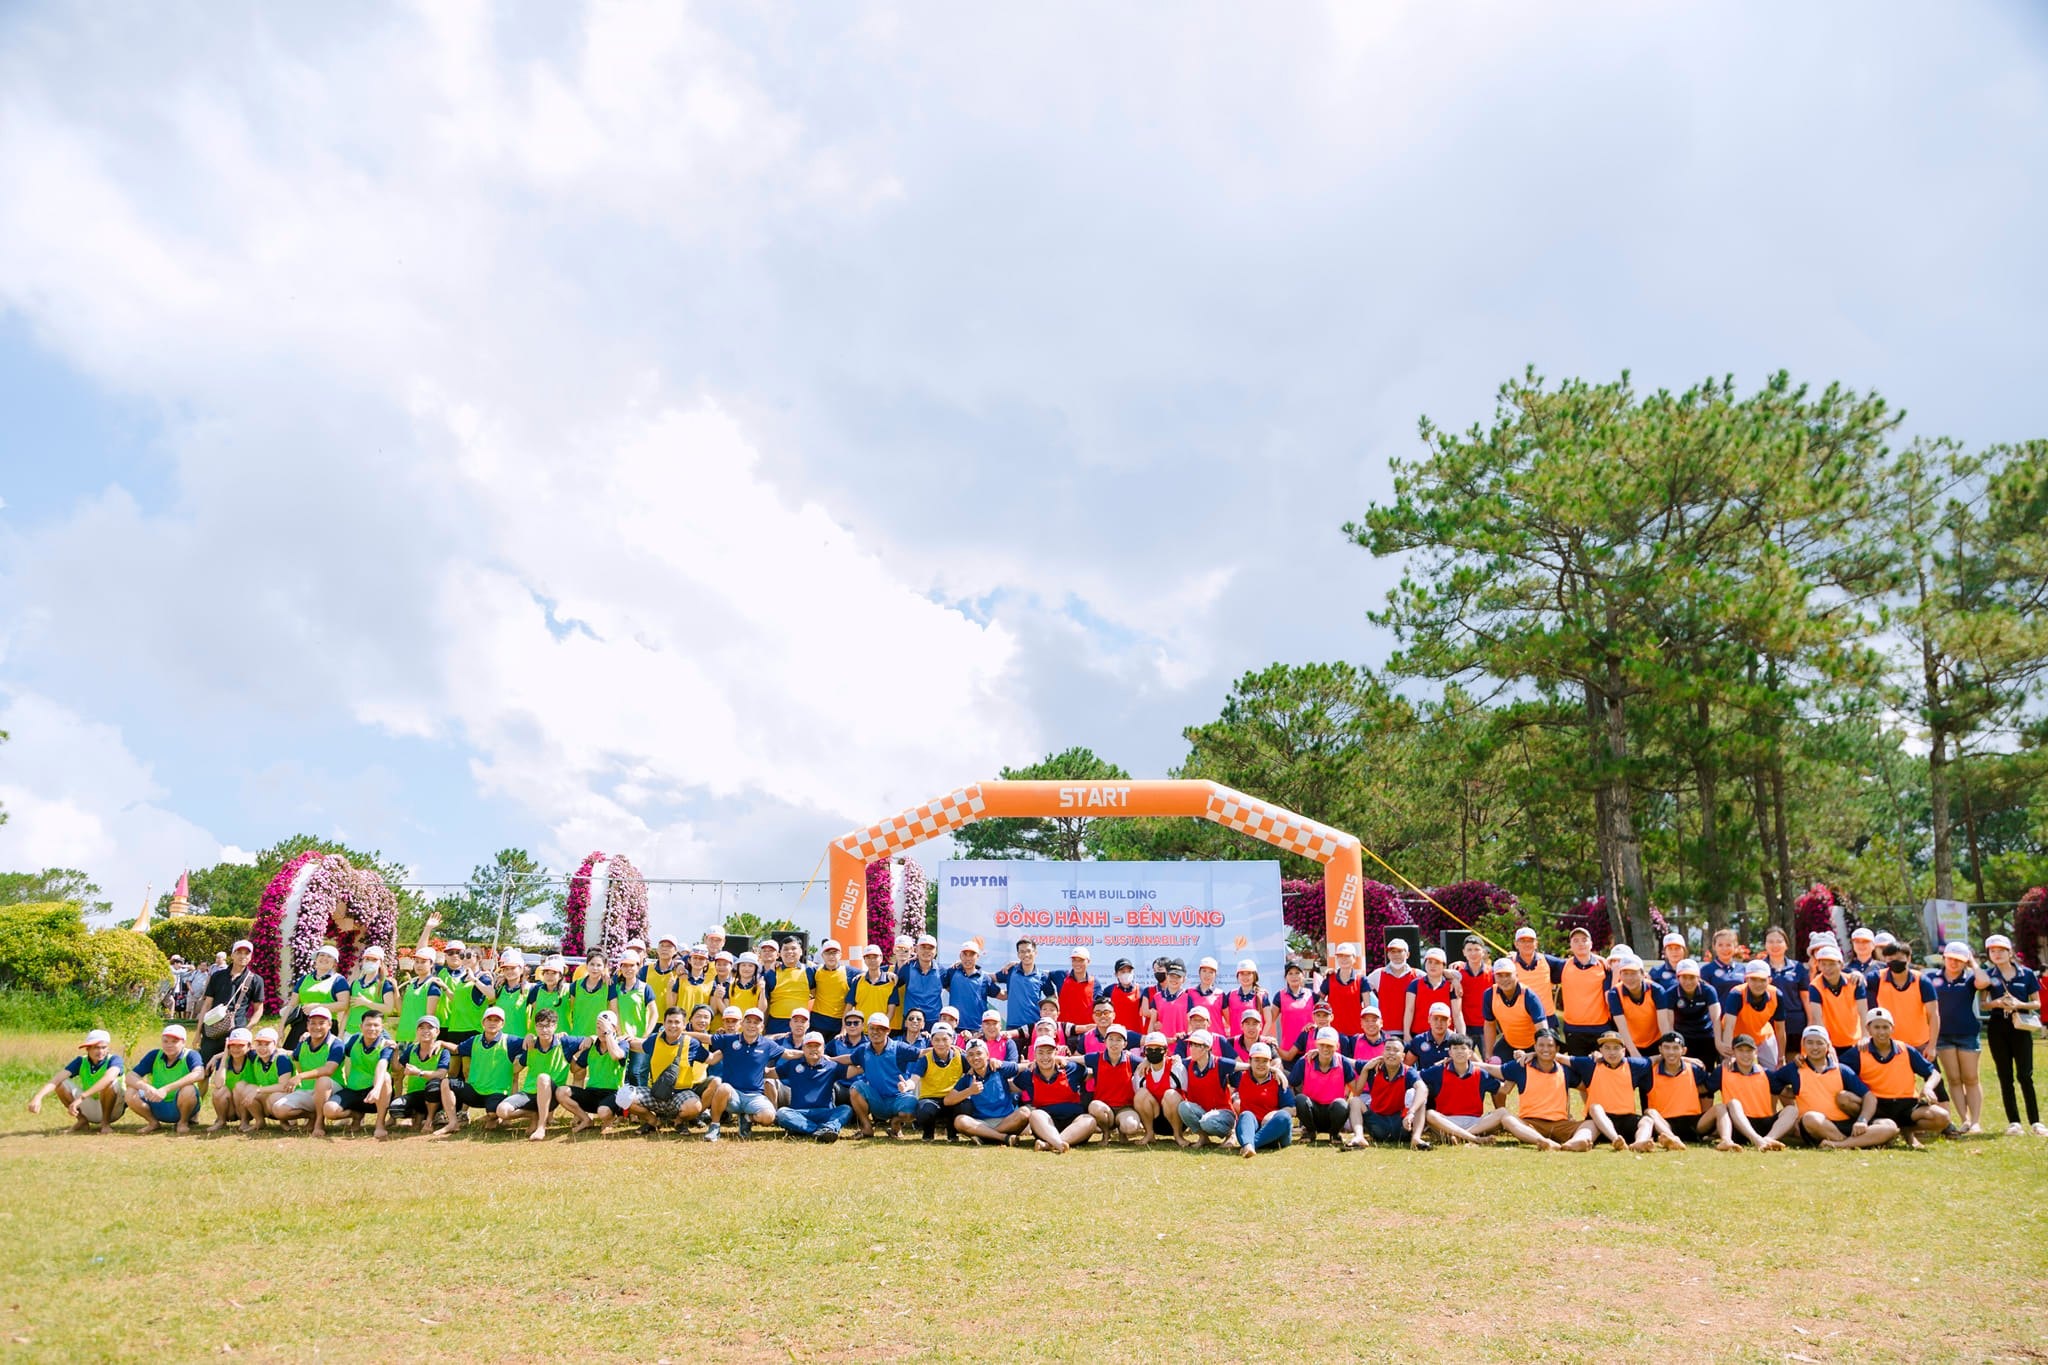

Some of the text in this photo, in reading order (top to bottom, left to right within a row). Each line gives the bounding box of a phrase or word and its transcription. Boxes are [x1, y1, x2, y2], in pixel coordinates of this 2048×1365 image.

[1059, 787, 1131, 808] START
[950, 876, 1008, 887] DUYTAN
[835, 879, 861, 929] ROBUST
[1062, 890, 1157, 900] TEAM BUILDING
[1333, 873, 1359, 929] SPEEDS
[995, 904, 1052, 928] ĐỒNG
[1055, 906, 1110, 928] HÀNH
[1126, 904, 1166, 928] BỀN
[1170, 905, 1225, 928] VỮNG
[1104, 935, 1199, 947] SUSTAINABILITY
